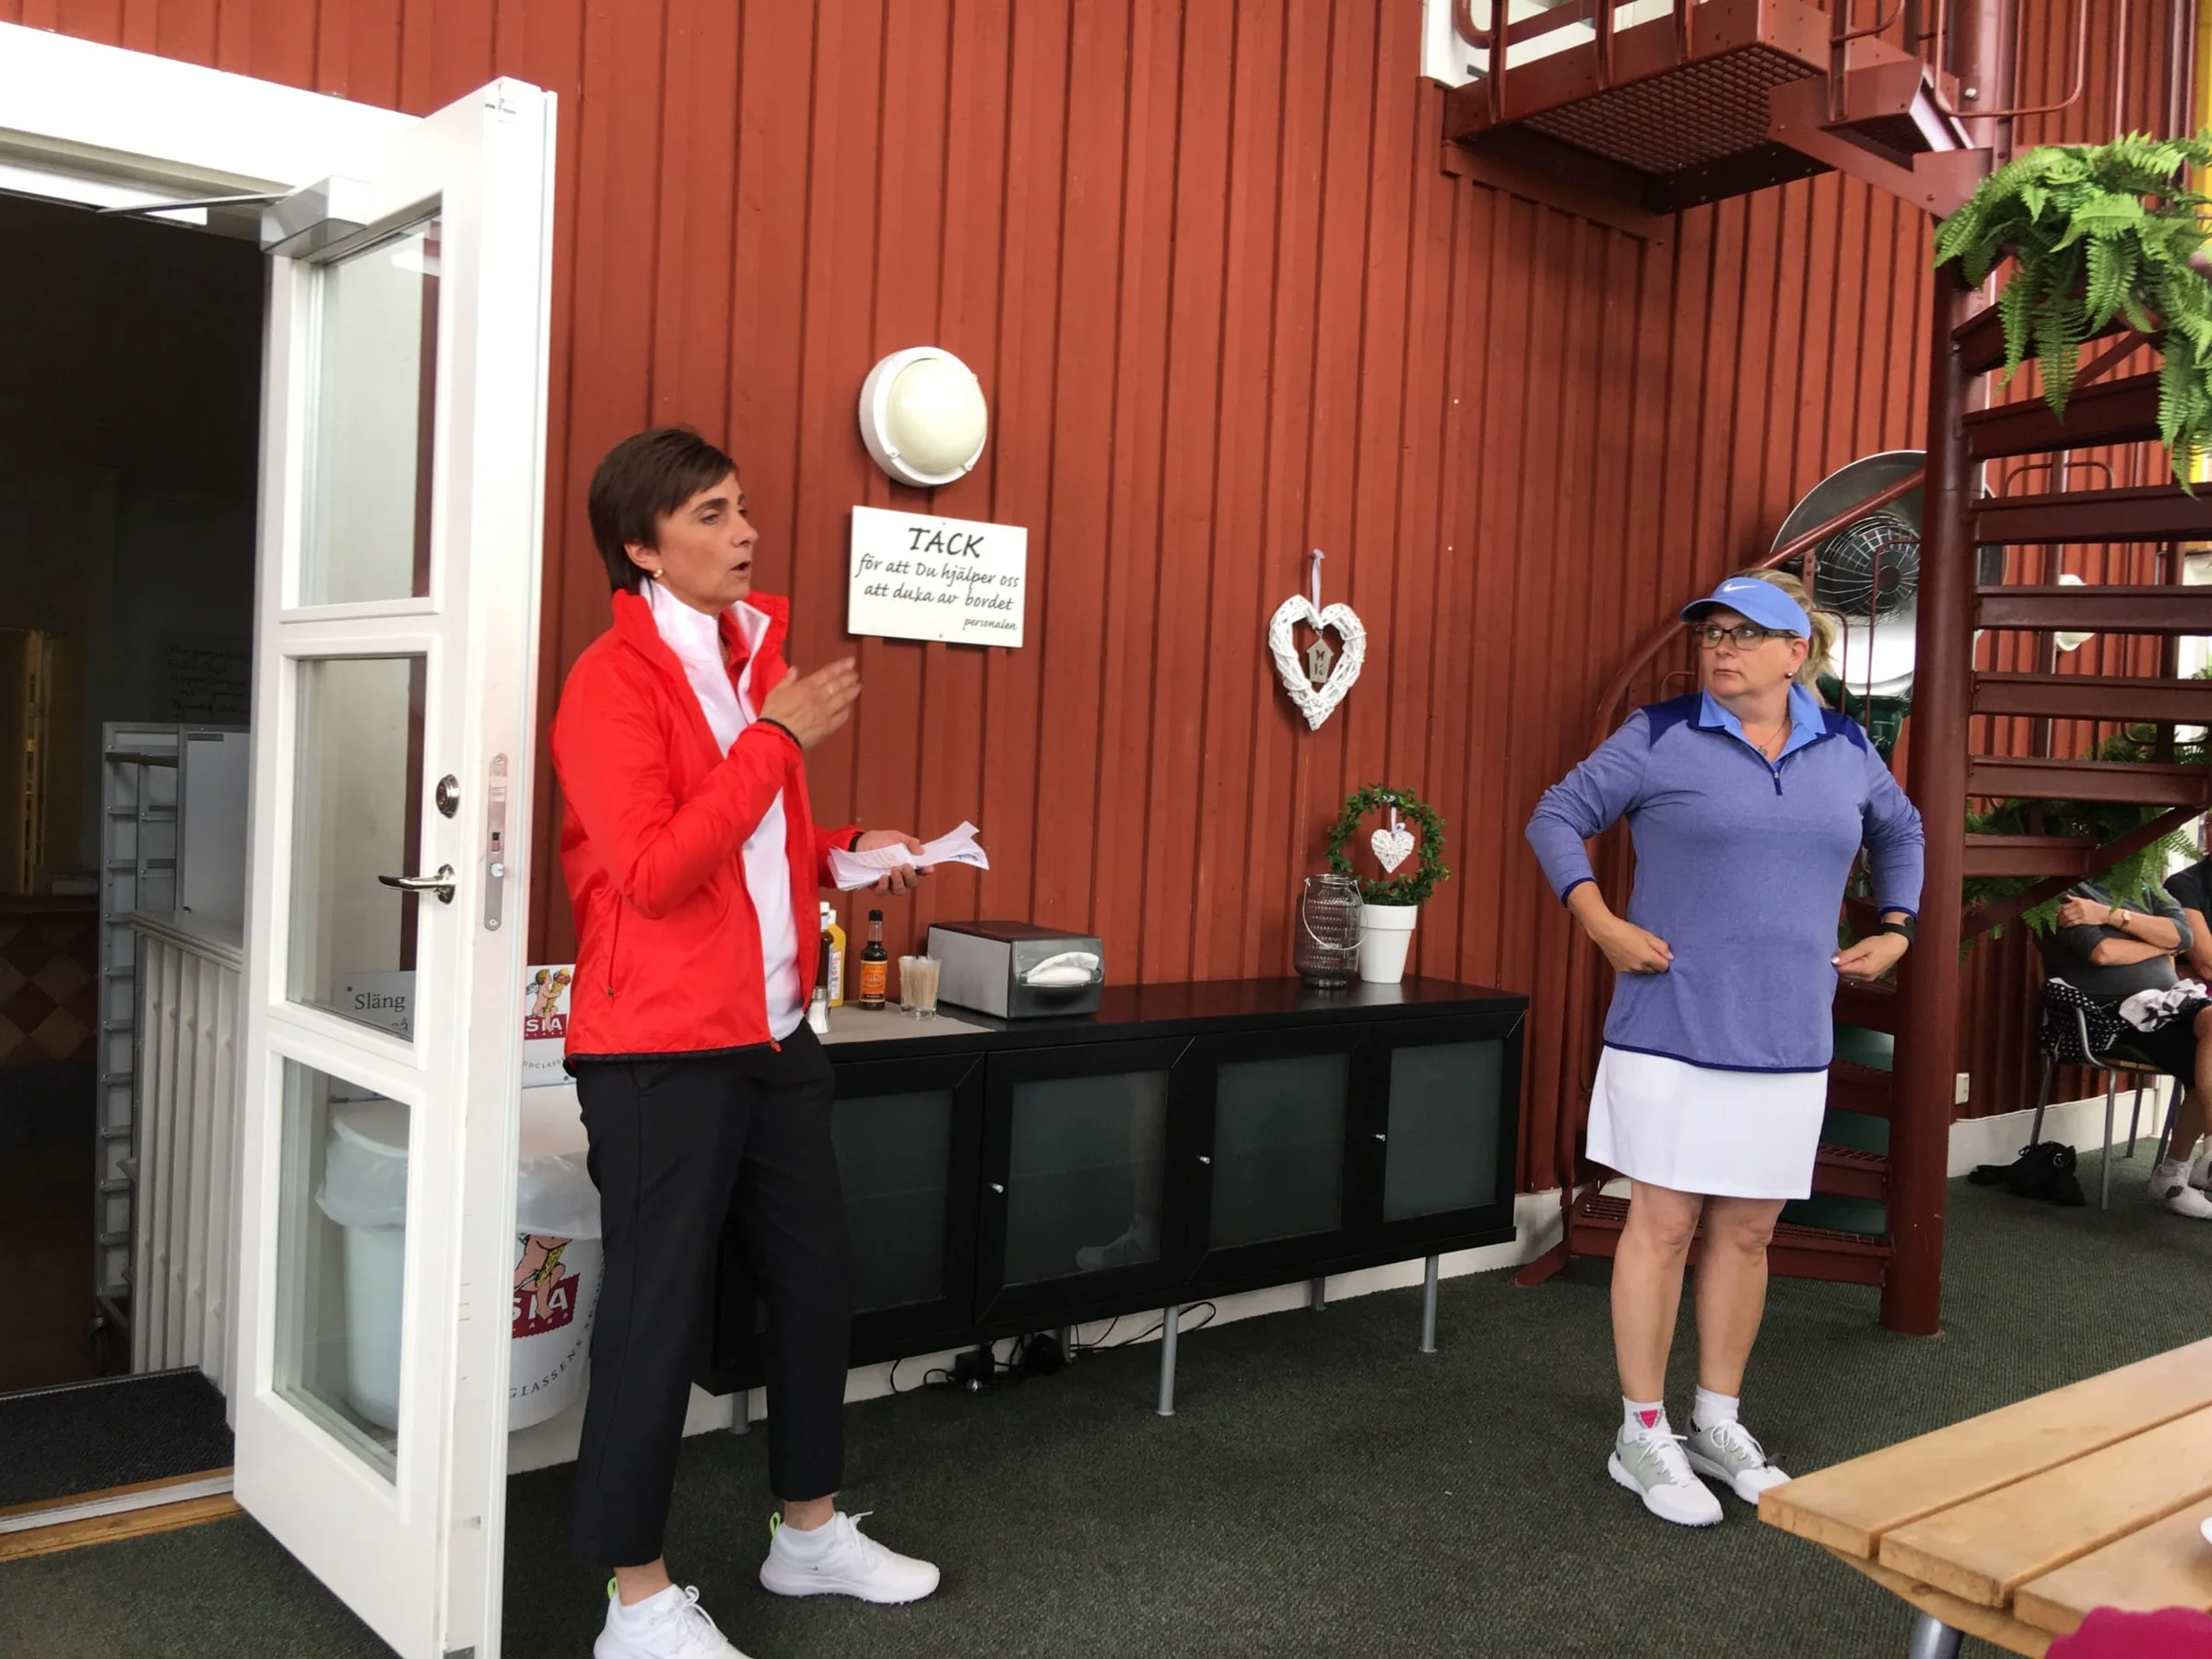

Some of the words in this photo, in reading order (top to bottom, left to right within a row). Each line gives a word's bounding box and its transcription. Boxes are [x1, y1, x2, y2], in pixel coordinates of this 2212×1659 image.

[908, 527, 984, 559] TACK
[854, 553, 882, 578] för
[886, 560, 911, 575] att
[915, 562, 939, 578] Du
[941, 562, 995, 588] hjälper
[999, 574, 1020, 587] oss
[864, 582, 889, 597] att
[892, 582, 935, 602] duka
[937, 593, 959, 605] av
[964, 591, 1014, 610] bordet
[962, 618, 1018, 631] personalen
[354, 992, 406, 1013] Släng
[525, 1018, 562, 1032] SIA
